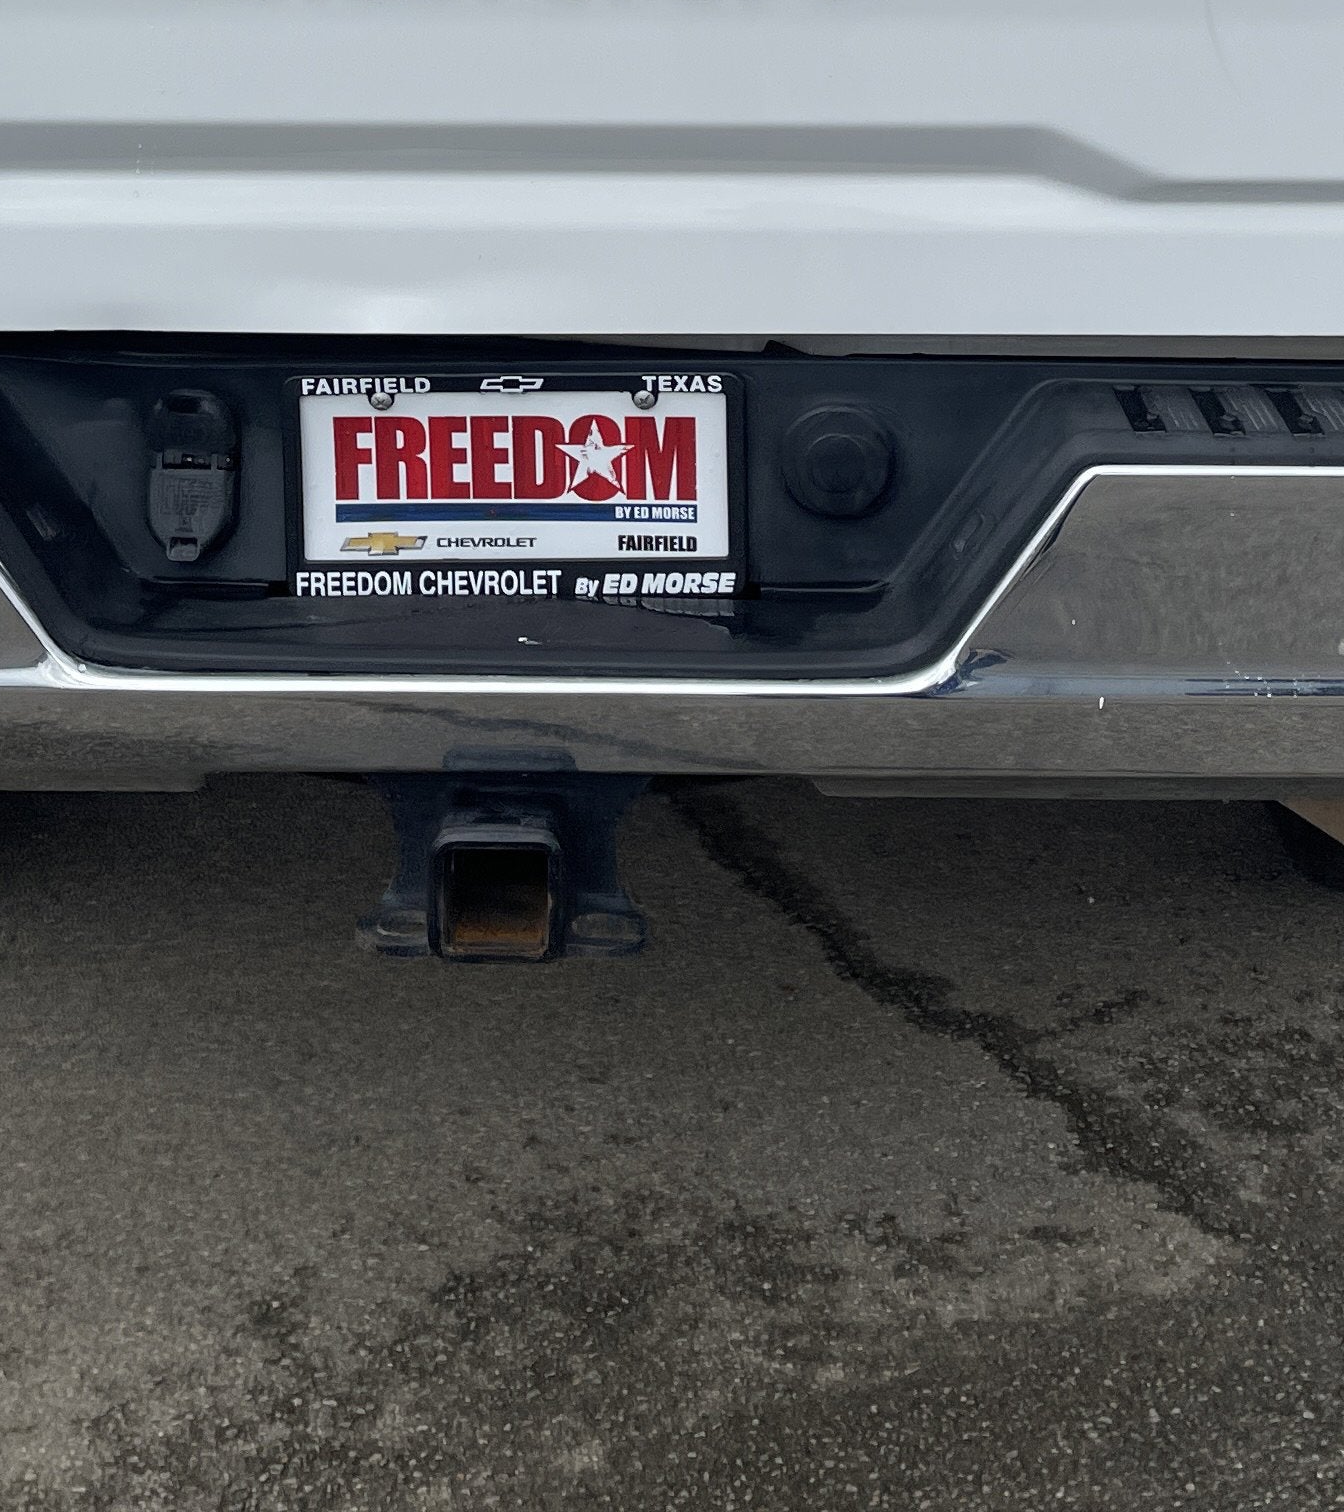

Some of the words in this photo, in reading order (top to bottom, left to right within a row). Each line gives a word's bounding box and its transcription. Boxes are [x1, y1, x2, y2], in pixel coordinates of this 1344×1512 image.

[301, 377, 431, 395] FAIRFIELD
[641, 375, 723, 393] TEXAS
[333, 414, 697, 502] FREEDOM
[614, 506, 631, 519] BY
[634, 506, 649, 520] ED
[652, 507, 695, 520] MORSE
[436, 537, 537, 548] CHEVROLET
[617, 535, 698, 552] FAIRFIELD
[296, 571, 412, 597] FREEDOM
[419, 570, 562, 596] CHEVROLET
[574, 577, 600, 597] By
[602, 573, 639, 595] ED
[641, 572, 737, 595] MORSE
